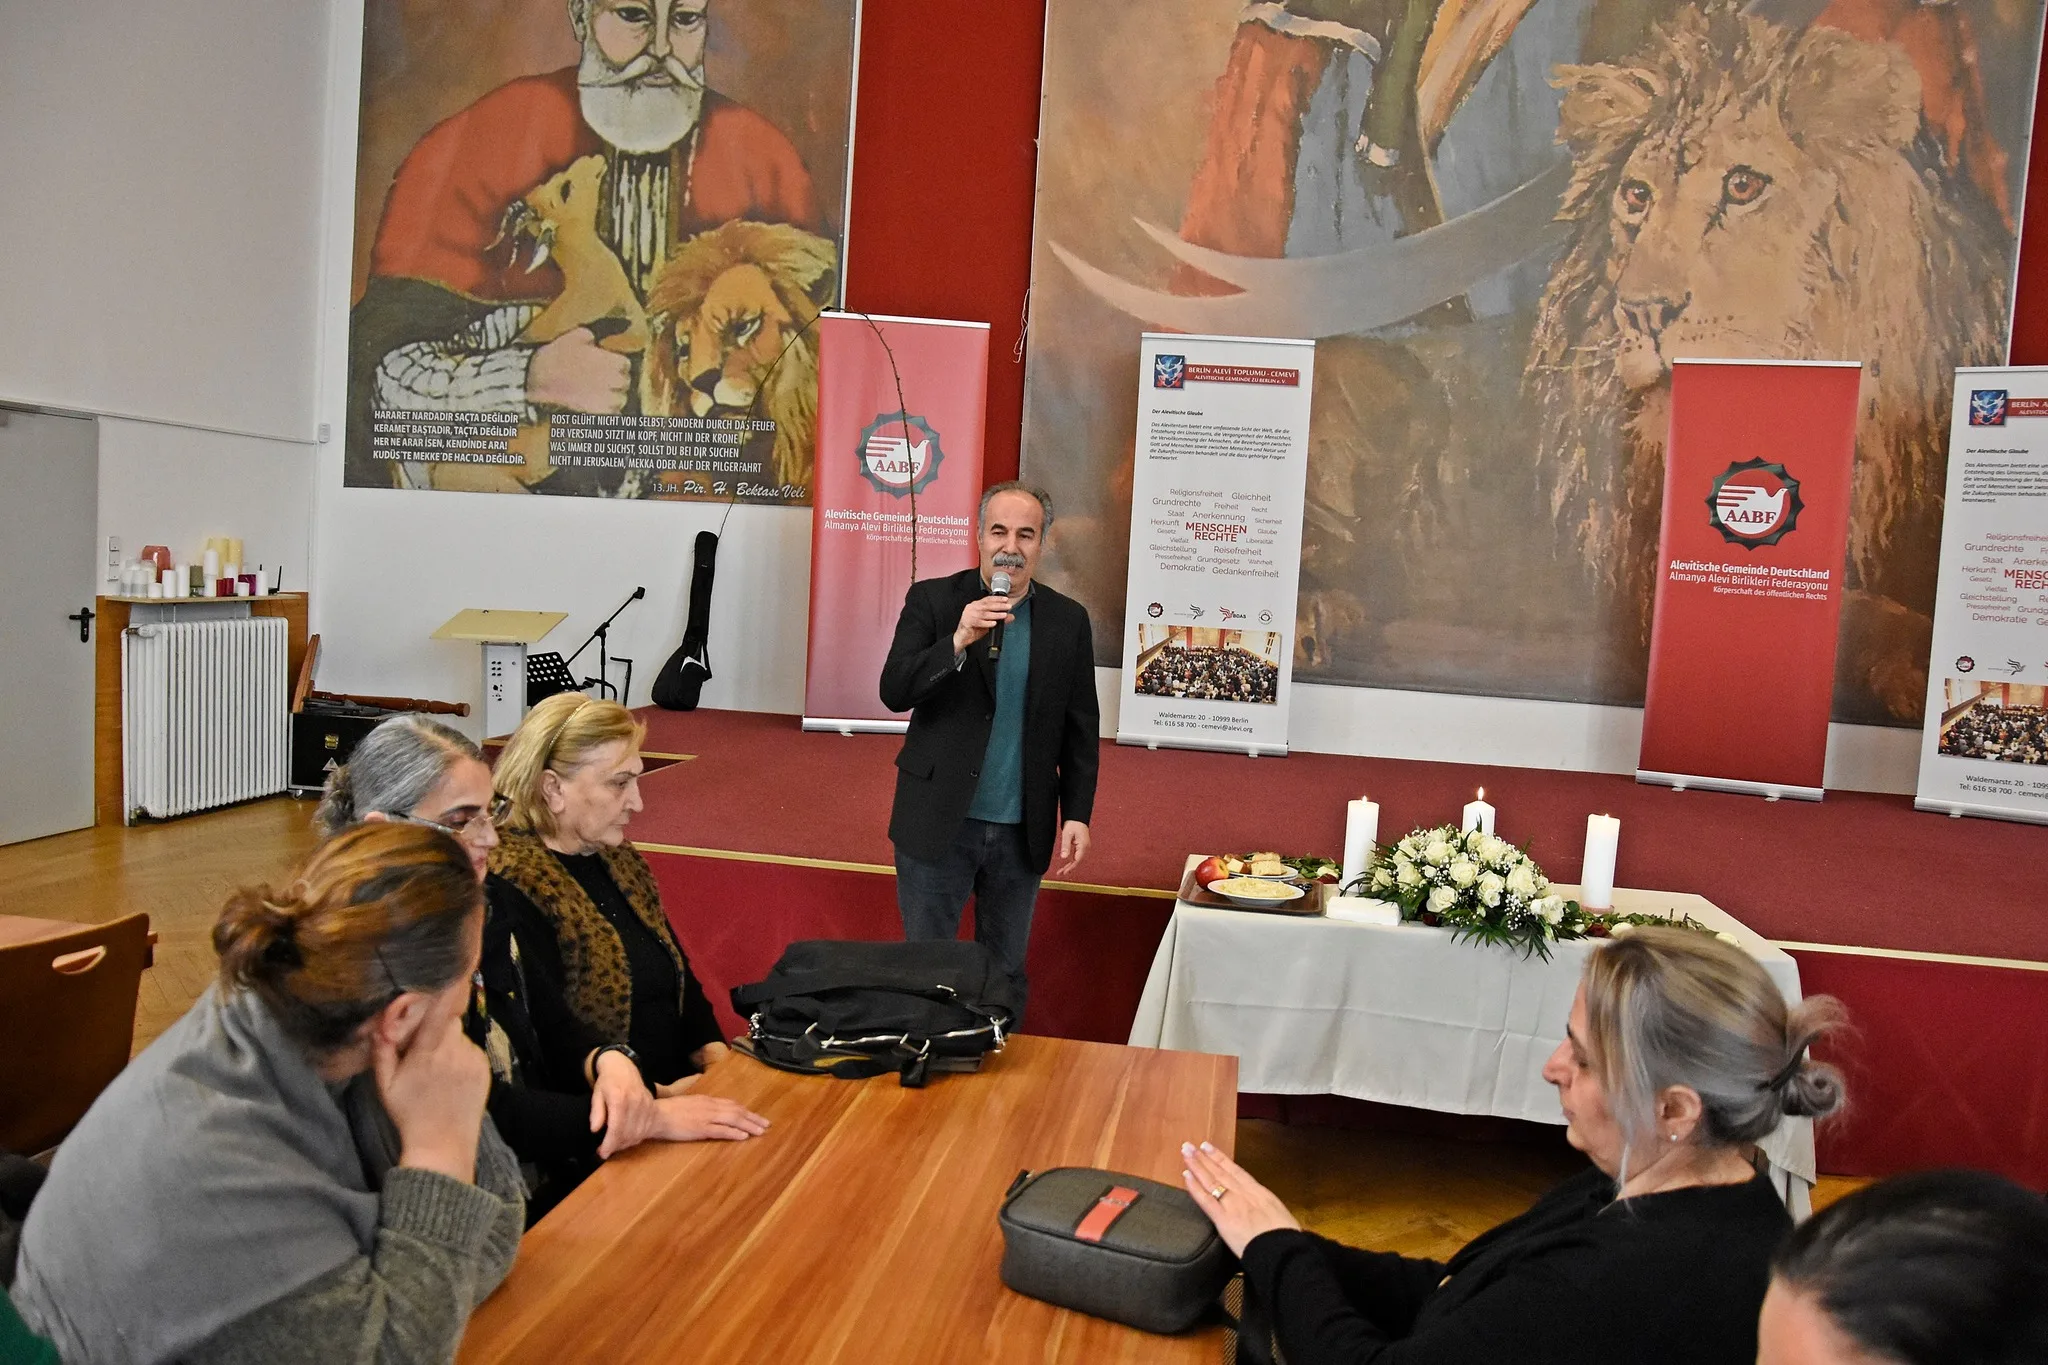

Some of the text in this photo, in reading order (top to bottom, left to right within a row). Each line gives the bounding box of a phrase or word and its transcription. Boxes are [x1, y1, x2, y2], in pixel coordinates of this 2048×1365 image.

[1233, 369, 1266, 377] TOPLUMU
[1270, 370, 1295, 378] CEMEVİ
[2012, 400, 2040, 408] BERLİN
[374, 411, 518, 424] HARARET NARDADIR SAÇTA DEĞİLDİR
[552, 414, 776, 431] ROST GLÜHT NICHT VON SELBST, SONDERN DURCH DAS FEUER
[374, 424, 517, 437] KERAMET BAŞTADIR, TAÇTA DEĞİLDİR
[551, 429, 738, 444] DER VERSTAND SITZT IM KOPF, NICHT IN DER KRONE
[374, 436, 507, 450] HER NE ARAR İSEN, KENDİNDE ARA!
[550, 442, 566, 452] WAS
[568, 442, 592, 453] IMMER
[594, 443, 605, 453] DU
[607, 444, 636, 455] SUCHST,
[638, 445, 664, 455] SOLLST
[666, 446, 677, 456] DU
[679, 446, 692, 456] BEI
[709, 447, 739, 458] SUCHEN
[486, 451, 525, 464] DEĞİLDİR.
[550, 455, 762, 473] NICHT IN JERUSALEM, MEKKA ODER AUF DER PILGERFAHRT
[874, 459, 920, 474] AABF
[683, 481, 706, 494] Pir.
[713, 481, 728, 494] H.
[782, 484, 805, 498] Veli
[1170, 489, 1223, 498] Religionsfreiheit
[1152, 498, 1201, 507] Grundrechte
[1232, 492, 1271, 502] Gleichheit
[825, 509, 871, 520] Alevitische
[917, 514, 969, 526] Deutschland
[1192, 512, 1246, 523] Anerkennung
[1724, 510, 1776, 524] AABF
[825, 520, 859, 531] Almanya
[861, 522, 881, 532] Alevi
[919, 526, 968, 537] Federasyonu
[1185, 522, 1247, 534] MENSCHEN
[866, 534, 902, 543] Körperschaft
[950, 538, 968, 546] Rechts
[1194, 532, 1237, 542] RECHTE
[1150, 544, 1197, 554] Gleichstellung
[1214, 546, 1262, 556] Reisefreiheit
[1965, 543, 2024, 552] Grundrechte
[1197, 556, 1240, 565] Grundgesetz
[1982, 556, 2003, 564] Staat
[1160, 563, 1205, 572] Demokratie
[1212, 567, 1279, 578] Gedankenfreiheit
[1670, 560, 1829, 579] Alevitische Gemeinde Deutschland
[1670, 572, 1828, 591] Almanya Alevi Birlikleri Federasyonu
[1713, 586, 1827, 600] Körperschaft des öffentlichen Rechts
[1960, 593, 2017, 604] Gleichstellung
[1972, 613, 2027, 624] Demokratie
[1159, 712, 1197, 720] Waldemarstr.
[1201, 723, 1253, 733] cemevi@alevi.org
[1966, 775, 2012, 786] Waldemarstr.
